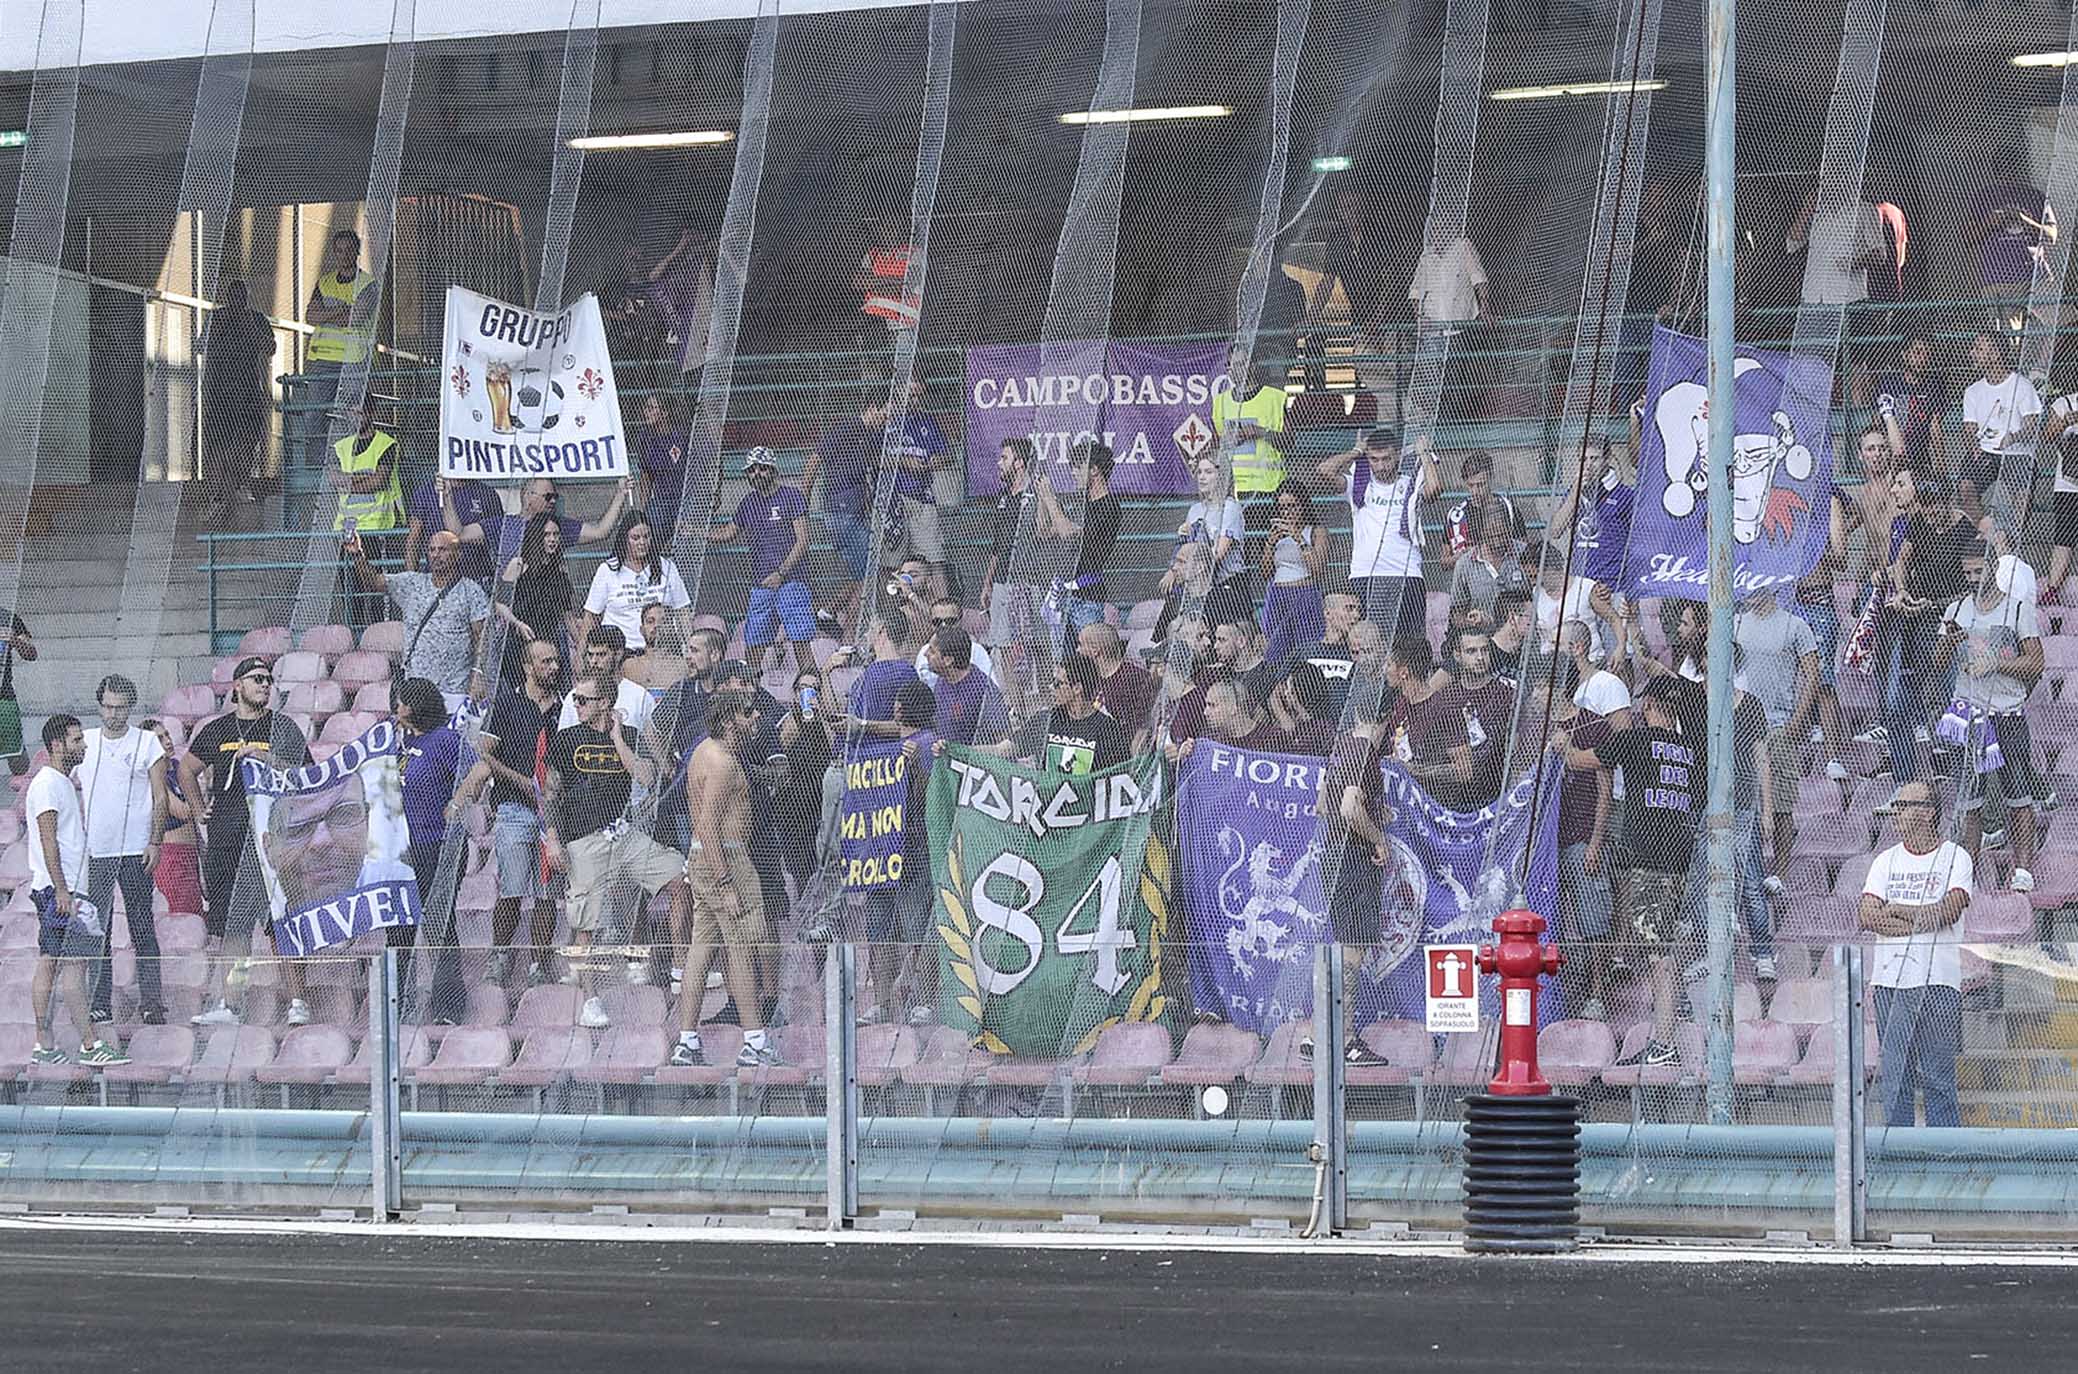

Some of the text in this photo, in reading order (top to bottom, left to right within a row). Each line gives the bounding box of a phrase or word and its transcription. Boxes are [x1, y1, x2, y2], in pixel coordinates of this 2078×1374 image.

[480, 303, 572, 350] GRUPPO
[974, 373, 1236, 409] CAMPOBASSO
[447, 434, 616, 474] PINTASPORT
[242, 720, 395, 792] TADDO
[950, 759, 1163, 839] TORCIDA
[872, 804, 903, 838] NON
[284, 885, 415, 957] VIVE!
[971, 851, 1137, 996] 84
[1430, 1020, 1475, 1028] SOPRASUOLO
[1439, 1011, 1472, 1019] COLONNA
